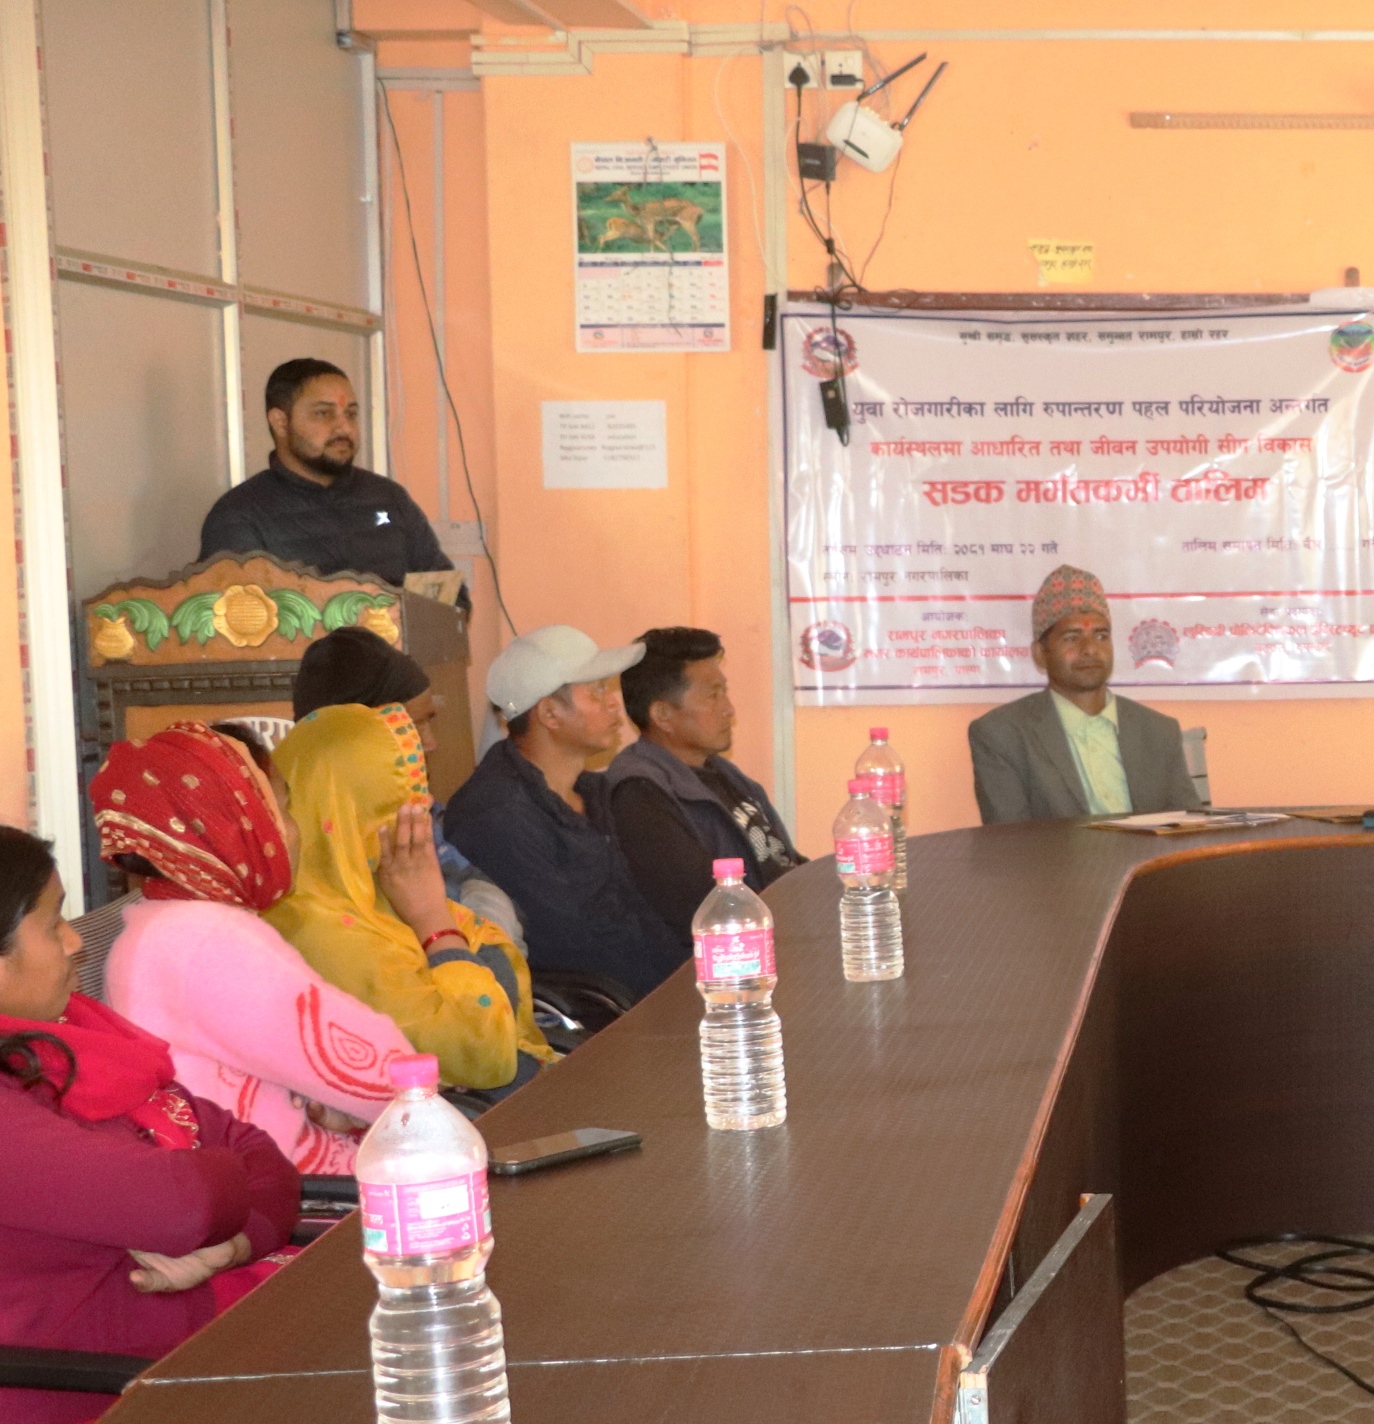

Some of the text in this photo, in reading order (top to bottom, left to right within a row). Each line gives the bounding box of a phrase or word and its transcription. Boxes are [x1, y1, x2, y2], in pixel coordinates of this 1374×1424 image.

[852, 400, 884, 424] युवा
[893, 396, 986, 418] रोजगारीका
[994, 396, 1035, 418] लागि
[1132, 399, 1171, 419] पहल
[1179, 394, 1261, 418] परियोजना
[870, 436, 963, 457] कार्यस्थलमा
[971, 434, 1042, 457] आधारित
[1049, 439, 1082, 457] तथा
[1090, 434, 1138, 456] जीवन
[1146, 433, 1210, 456] उपयोगी
[922, 479, 1006, 506] सडक
[1170, 469, 1271, 503] तालिम
